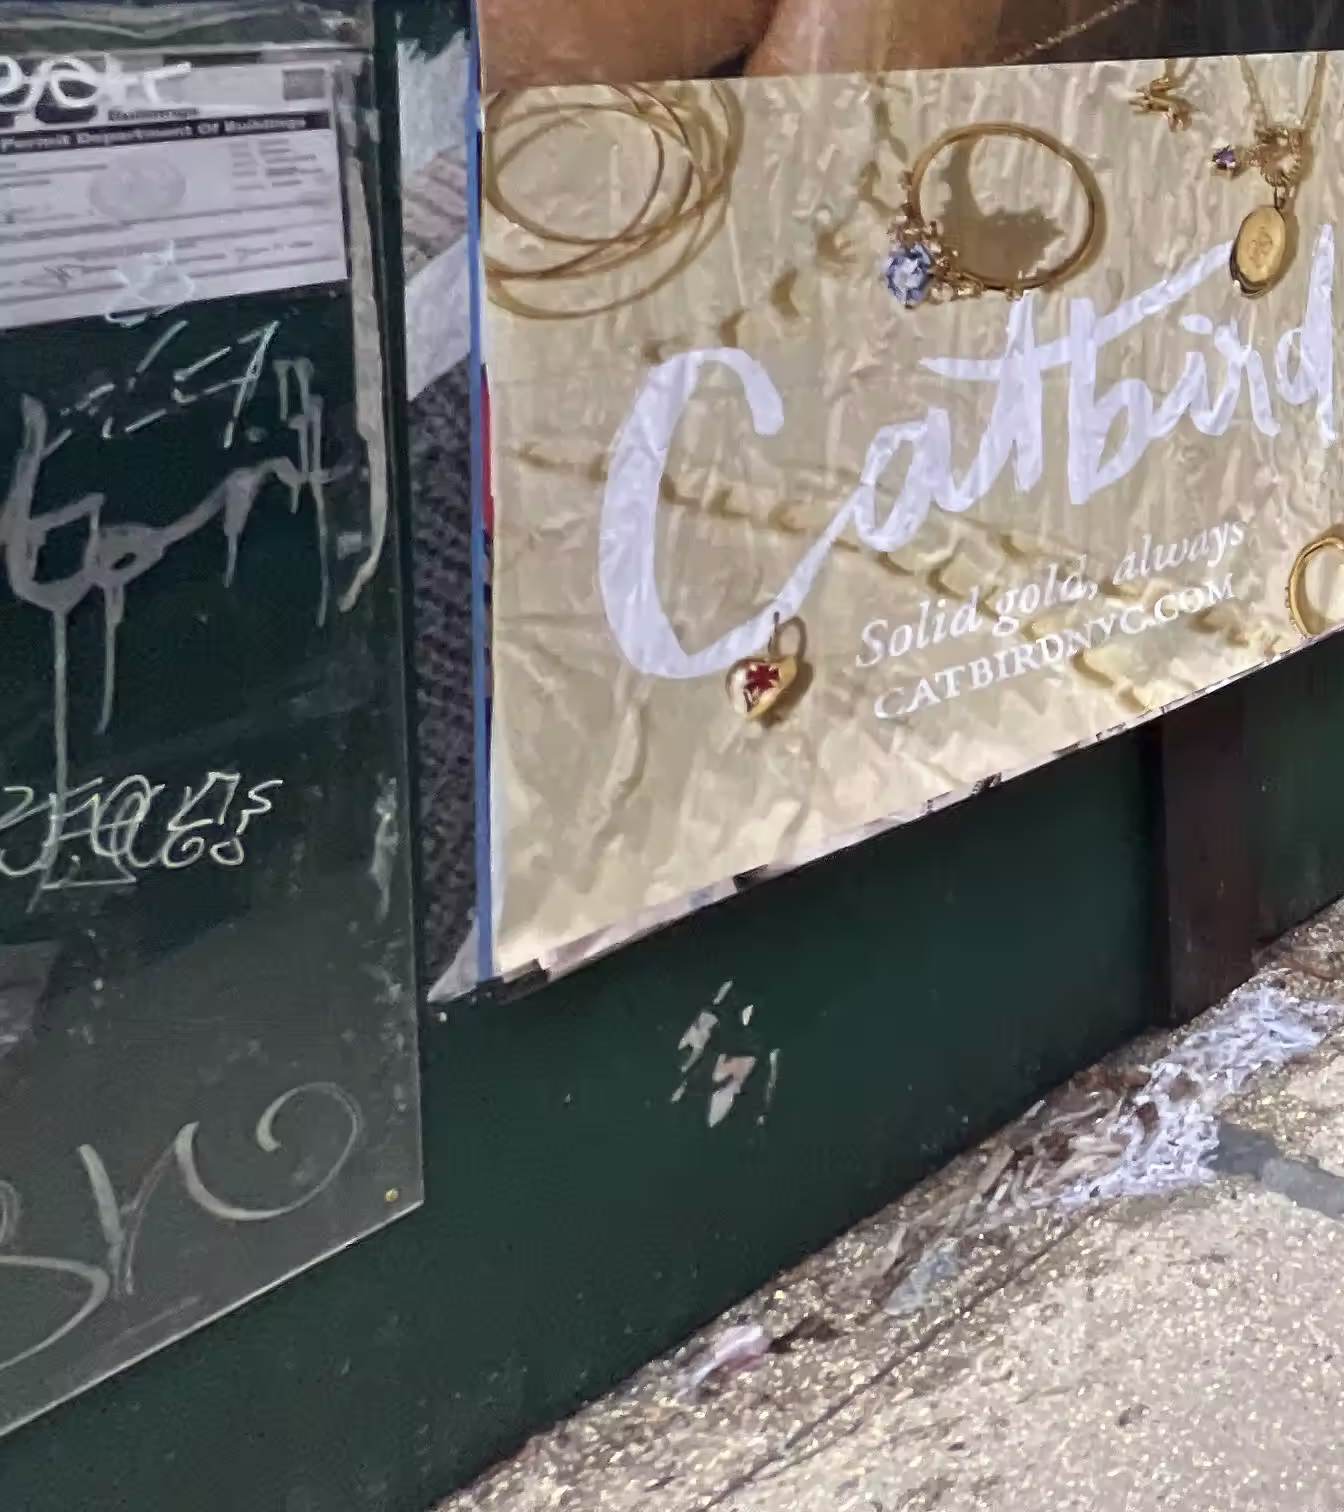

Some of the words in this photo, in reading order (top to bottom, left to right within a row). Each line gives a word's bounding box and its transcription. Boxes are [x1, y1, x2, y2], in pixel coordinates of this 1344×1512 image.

[599, 224, 1337, 679] Catbird
[854, 598, 981, 670] Solid
[991, 555, 1099, 639] gold,
[1112, 520, 1248, 586] always
[873, 572, 1236, 720] CATBIRDNYC.COM
